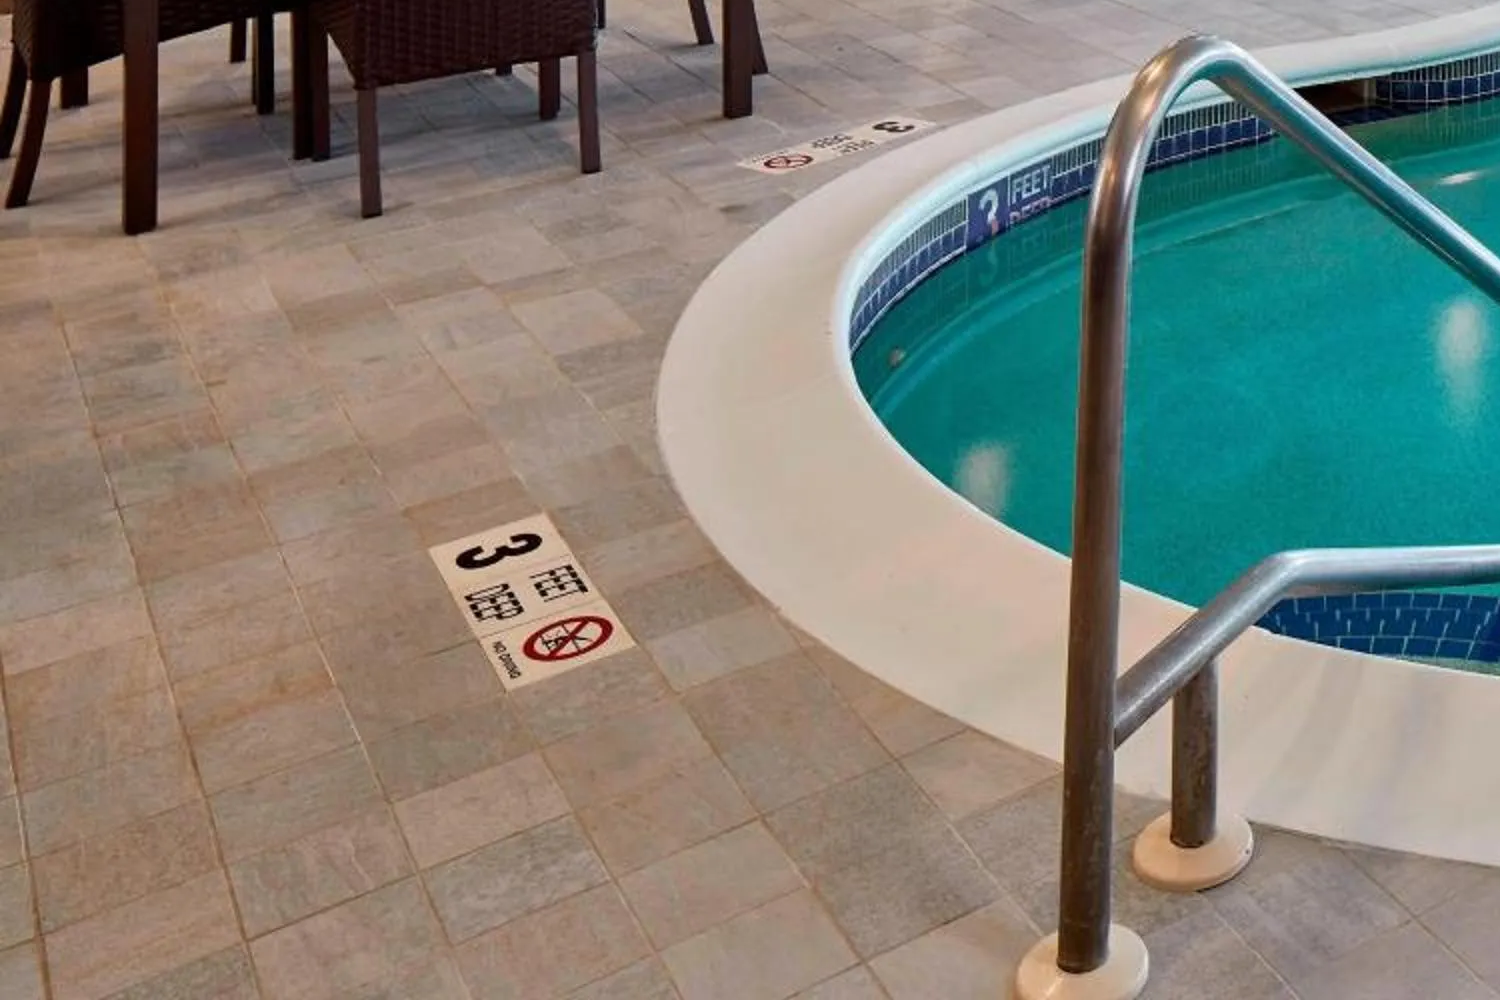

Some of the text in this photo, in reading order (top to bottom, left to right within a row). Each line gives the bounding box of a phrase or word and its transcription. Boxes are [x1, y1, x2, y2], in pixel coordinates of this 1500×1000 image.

[1012, 165, 1051, 205] FEET
[456, 533, 543, 570] 3
[464, 583, 525, 622] DEEP
[529, 564, 589, 603] FEET
